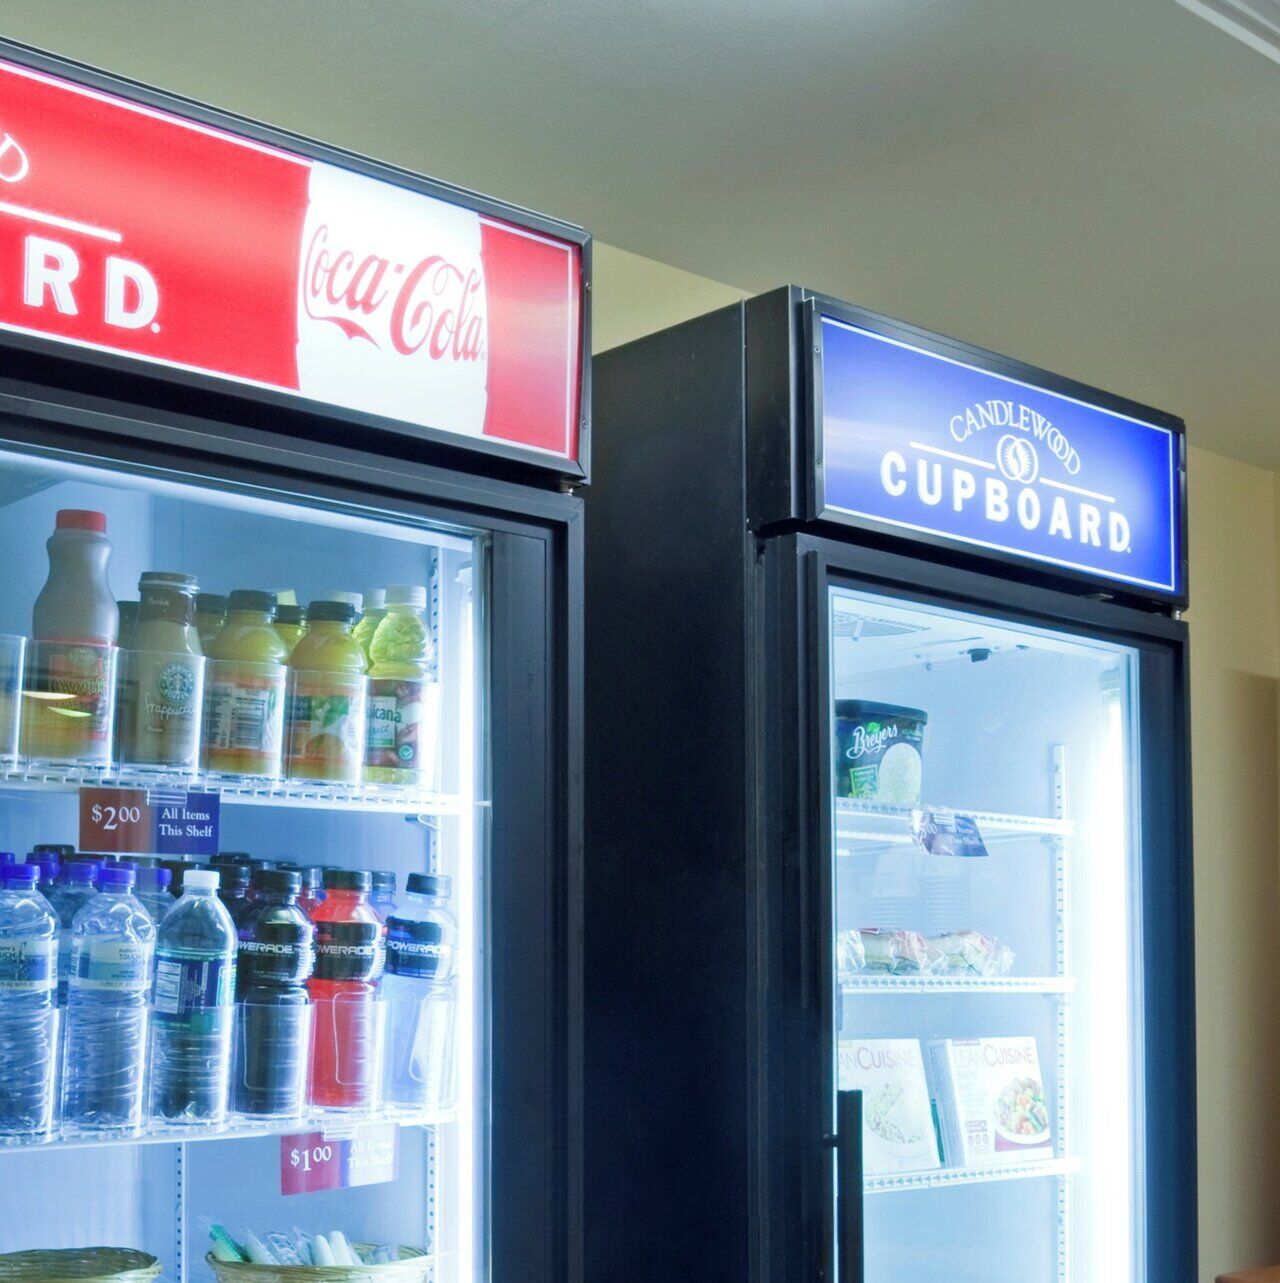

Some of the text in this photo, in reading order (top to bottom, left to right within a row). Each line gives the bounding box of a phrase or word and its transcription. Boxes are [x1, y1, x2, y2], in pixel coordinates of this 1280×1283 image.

[303, 224, 484, 362] Coca-Cola
[950, 400, 1081, 475] CANDLEWOOD
[880, 451, 1130, 552] CUPBOARD
[846, 724, 898, 760] Breyers
[158, 823, 213, 838] This Shelf
[161, 807, 210, 821] All Items
